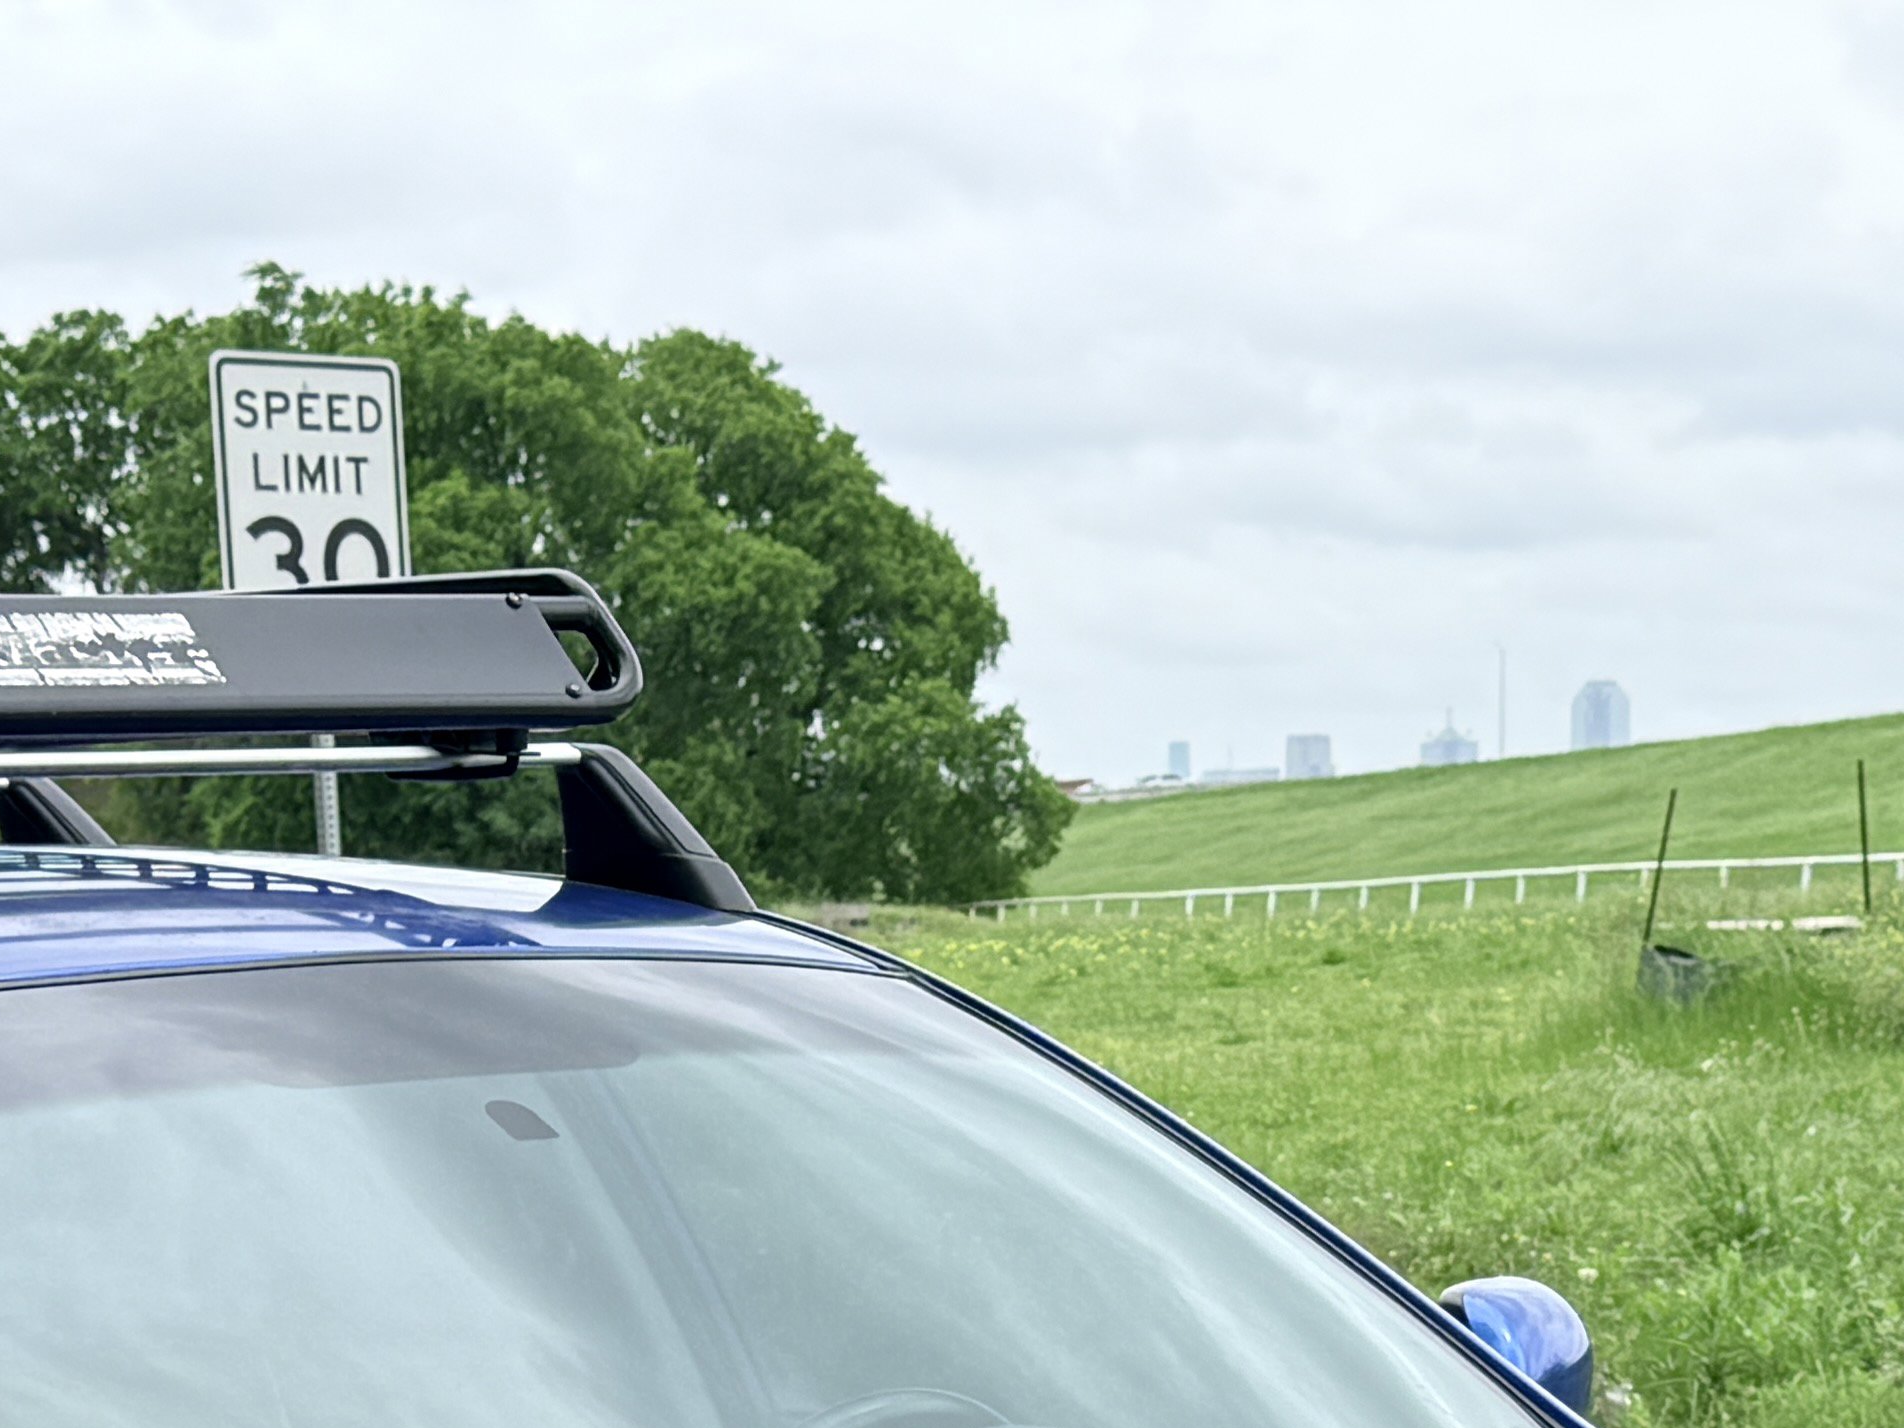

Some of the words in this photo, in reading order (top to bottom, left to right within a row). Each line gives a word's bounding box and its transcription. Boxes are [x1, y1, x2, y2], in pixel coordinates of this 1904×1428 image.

[234, 389, 382, 433] SPEED
[252, 452, 368, 495] LIMIT
[245, 515, 390, 584] 30
